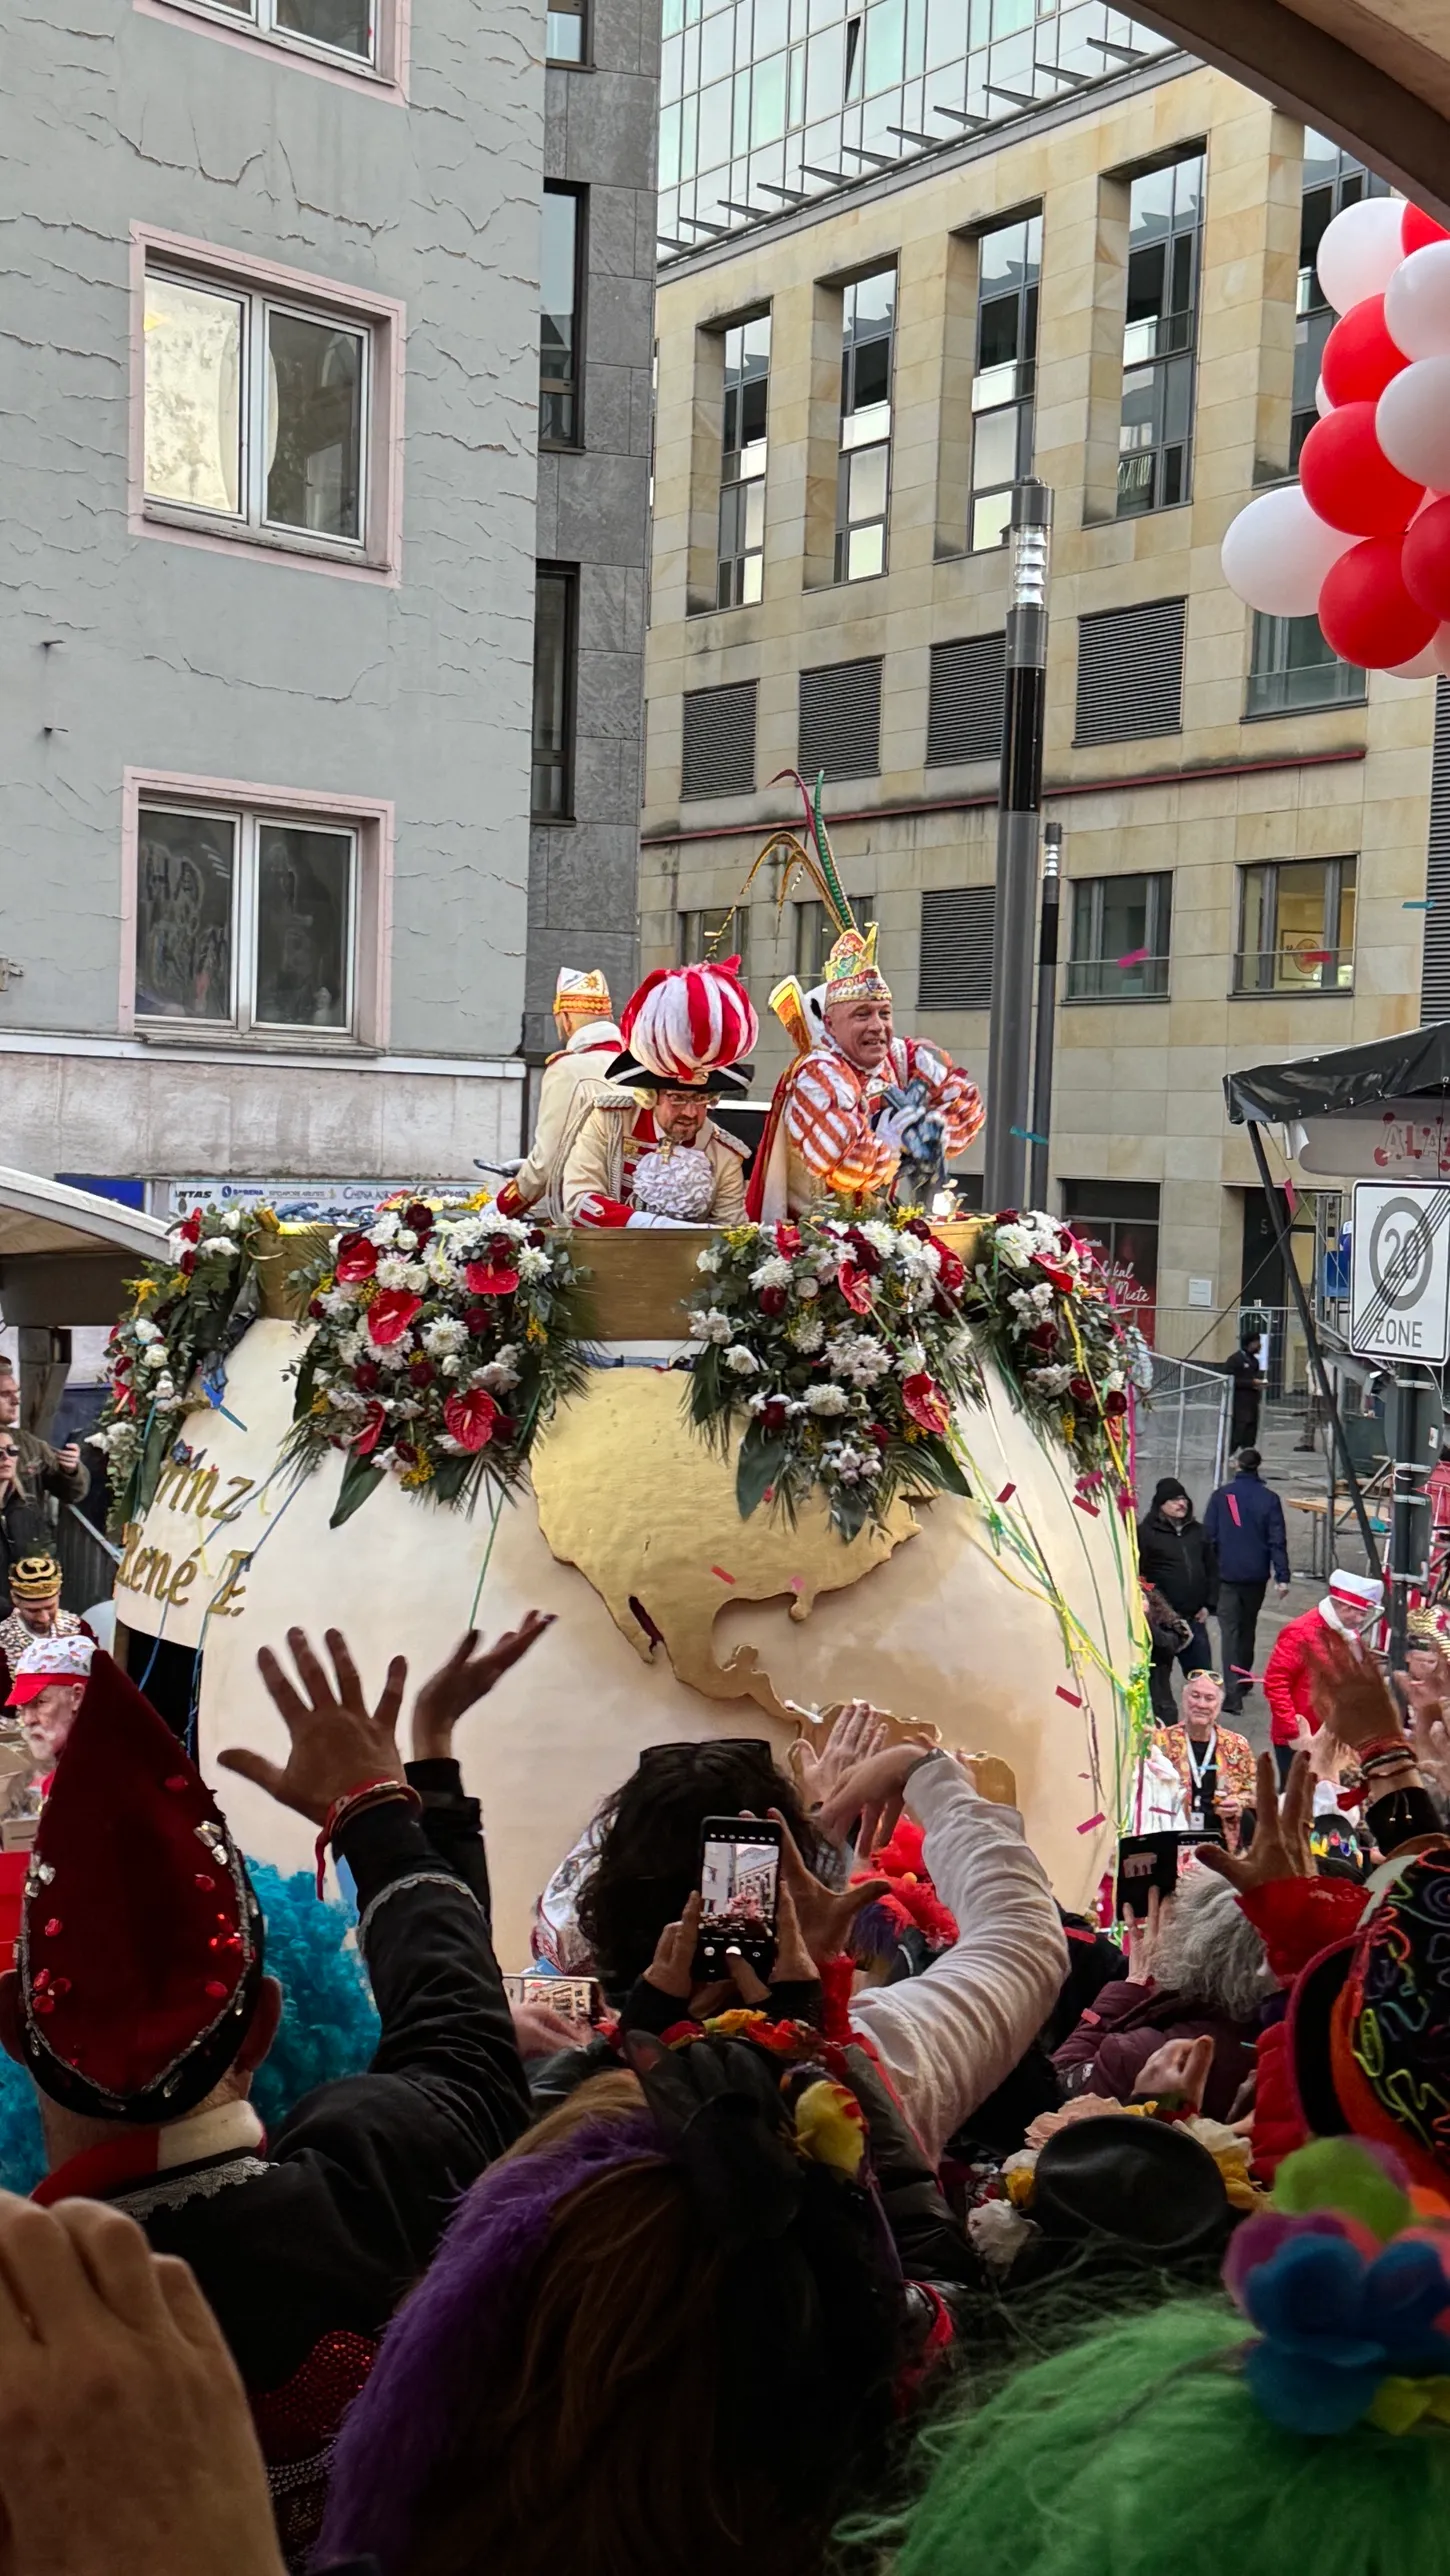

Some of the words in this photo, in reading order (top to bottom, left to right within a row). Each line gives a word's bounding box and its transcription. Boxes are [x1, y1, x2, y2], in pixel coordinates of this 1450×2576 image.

[1384, 1227, 1419, 1280] 20
[1374, 1317, 1423, 1349] ZONE
[155, 1460, 256, 1523] rinz
